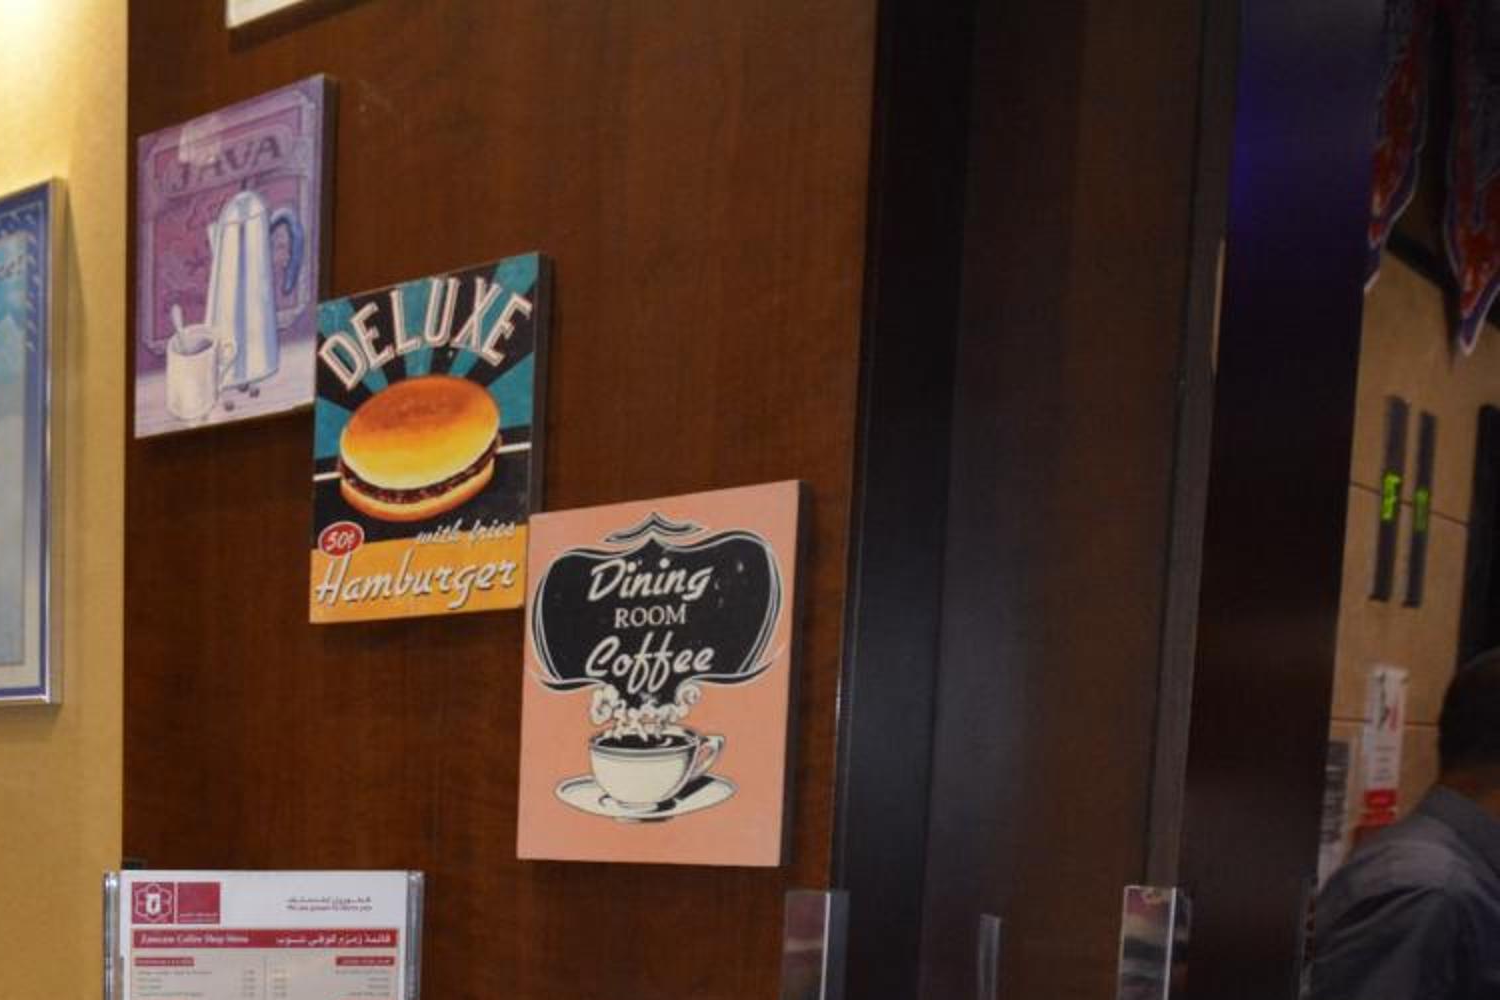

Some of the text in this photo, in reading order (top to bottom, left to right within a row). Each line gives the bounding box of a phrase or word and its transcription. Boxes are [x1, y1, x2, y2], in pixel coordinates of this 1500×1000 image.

[164, 136, 282, 193] JAVA
[319, 276, 534, 391] DELUXE
[417, 518, 518, 546] with fries
[315, 550, 518, 611] Hamburger
[587, 556, 715, 602] Dining
[613, 603, 689, 629] ROOM
[585, 630, 716, 694] Coffee
